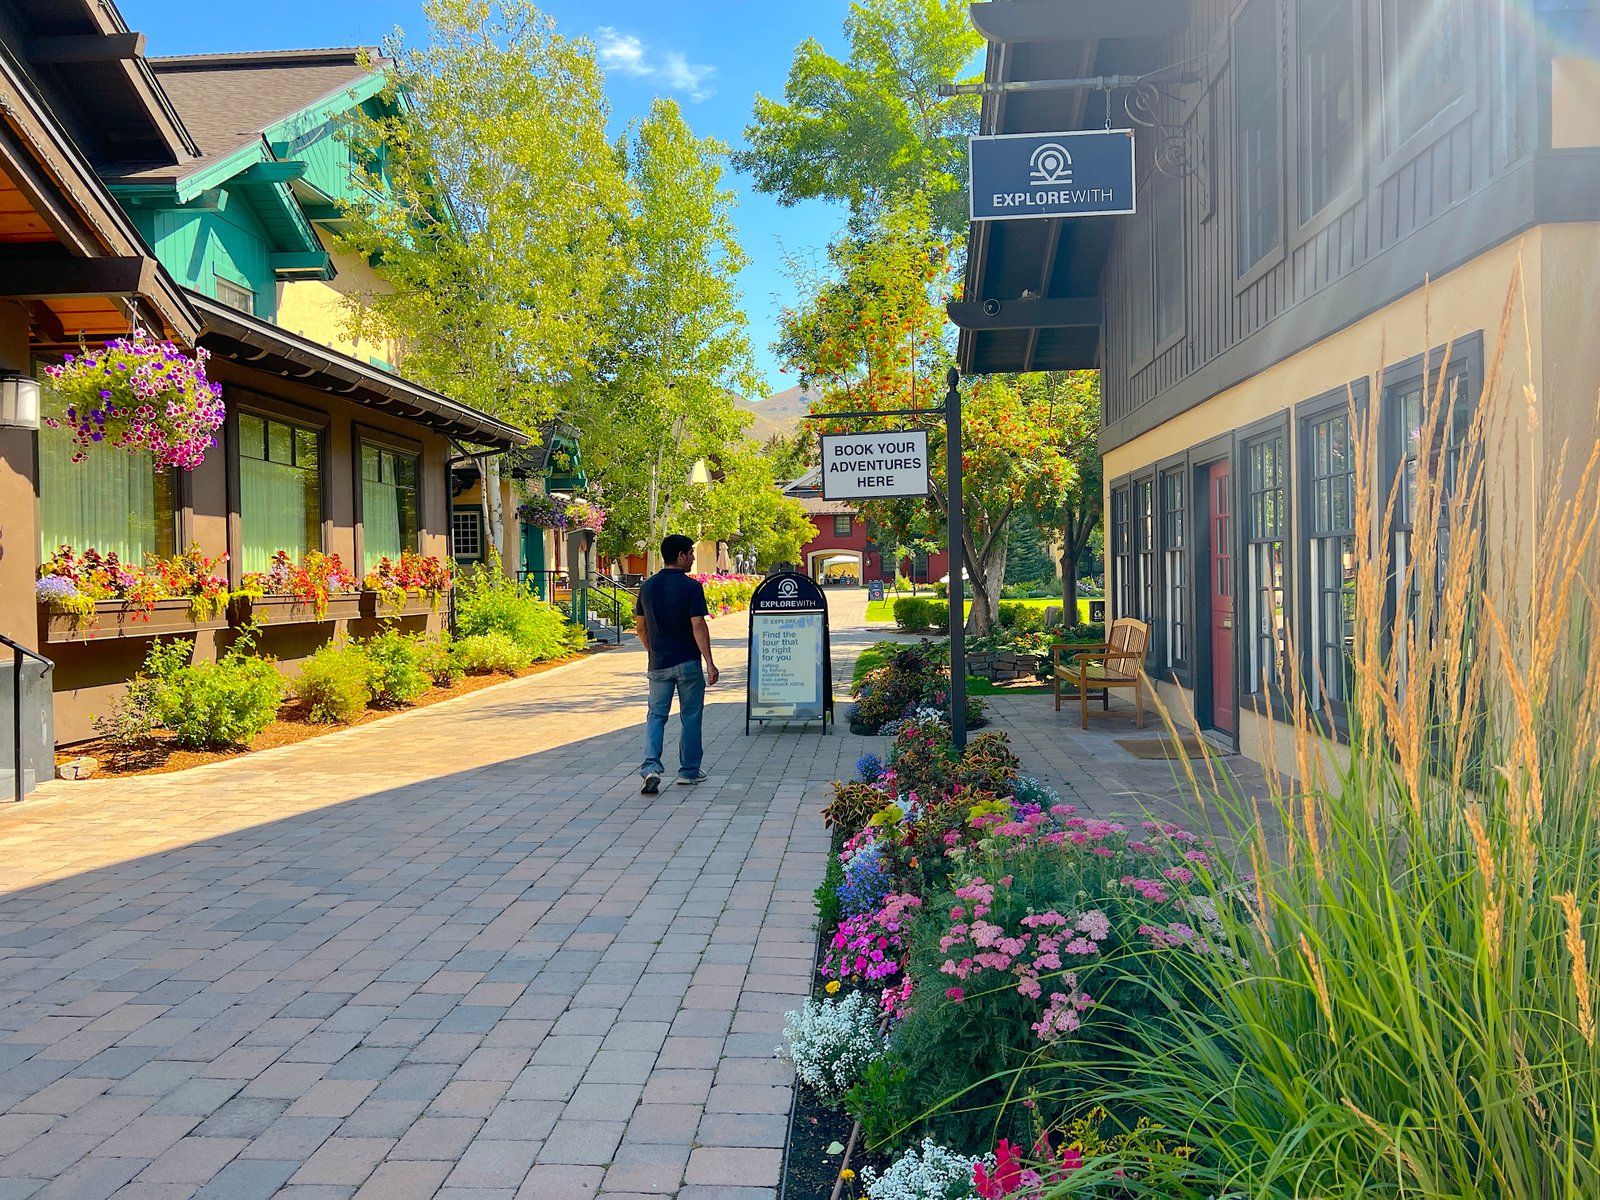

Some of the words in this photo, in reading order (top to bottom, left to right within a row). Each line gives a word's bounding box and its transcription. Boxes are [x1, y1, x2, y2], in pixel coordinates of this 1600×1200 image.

[835, 444, 874, 456] BOOK
[877, 442, 915, 454] YOUR
[830, 458, 921, 473] ADVENTURES
[857, 475, 894, 487] HERE
[771, 646, 791, 655] right
[776, 655, 791, 663] you
